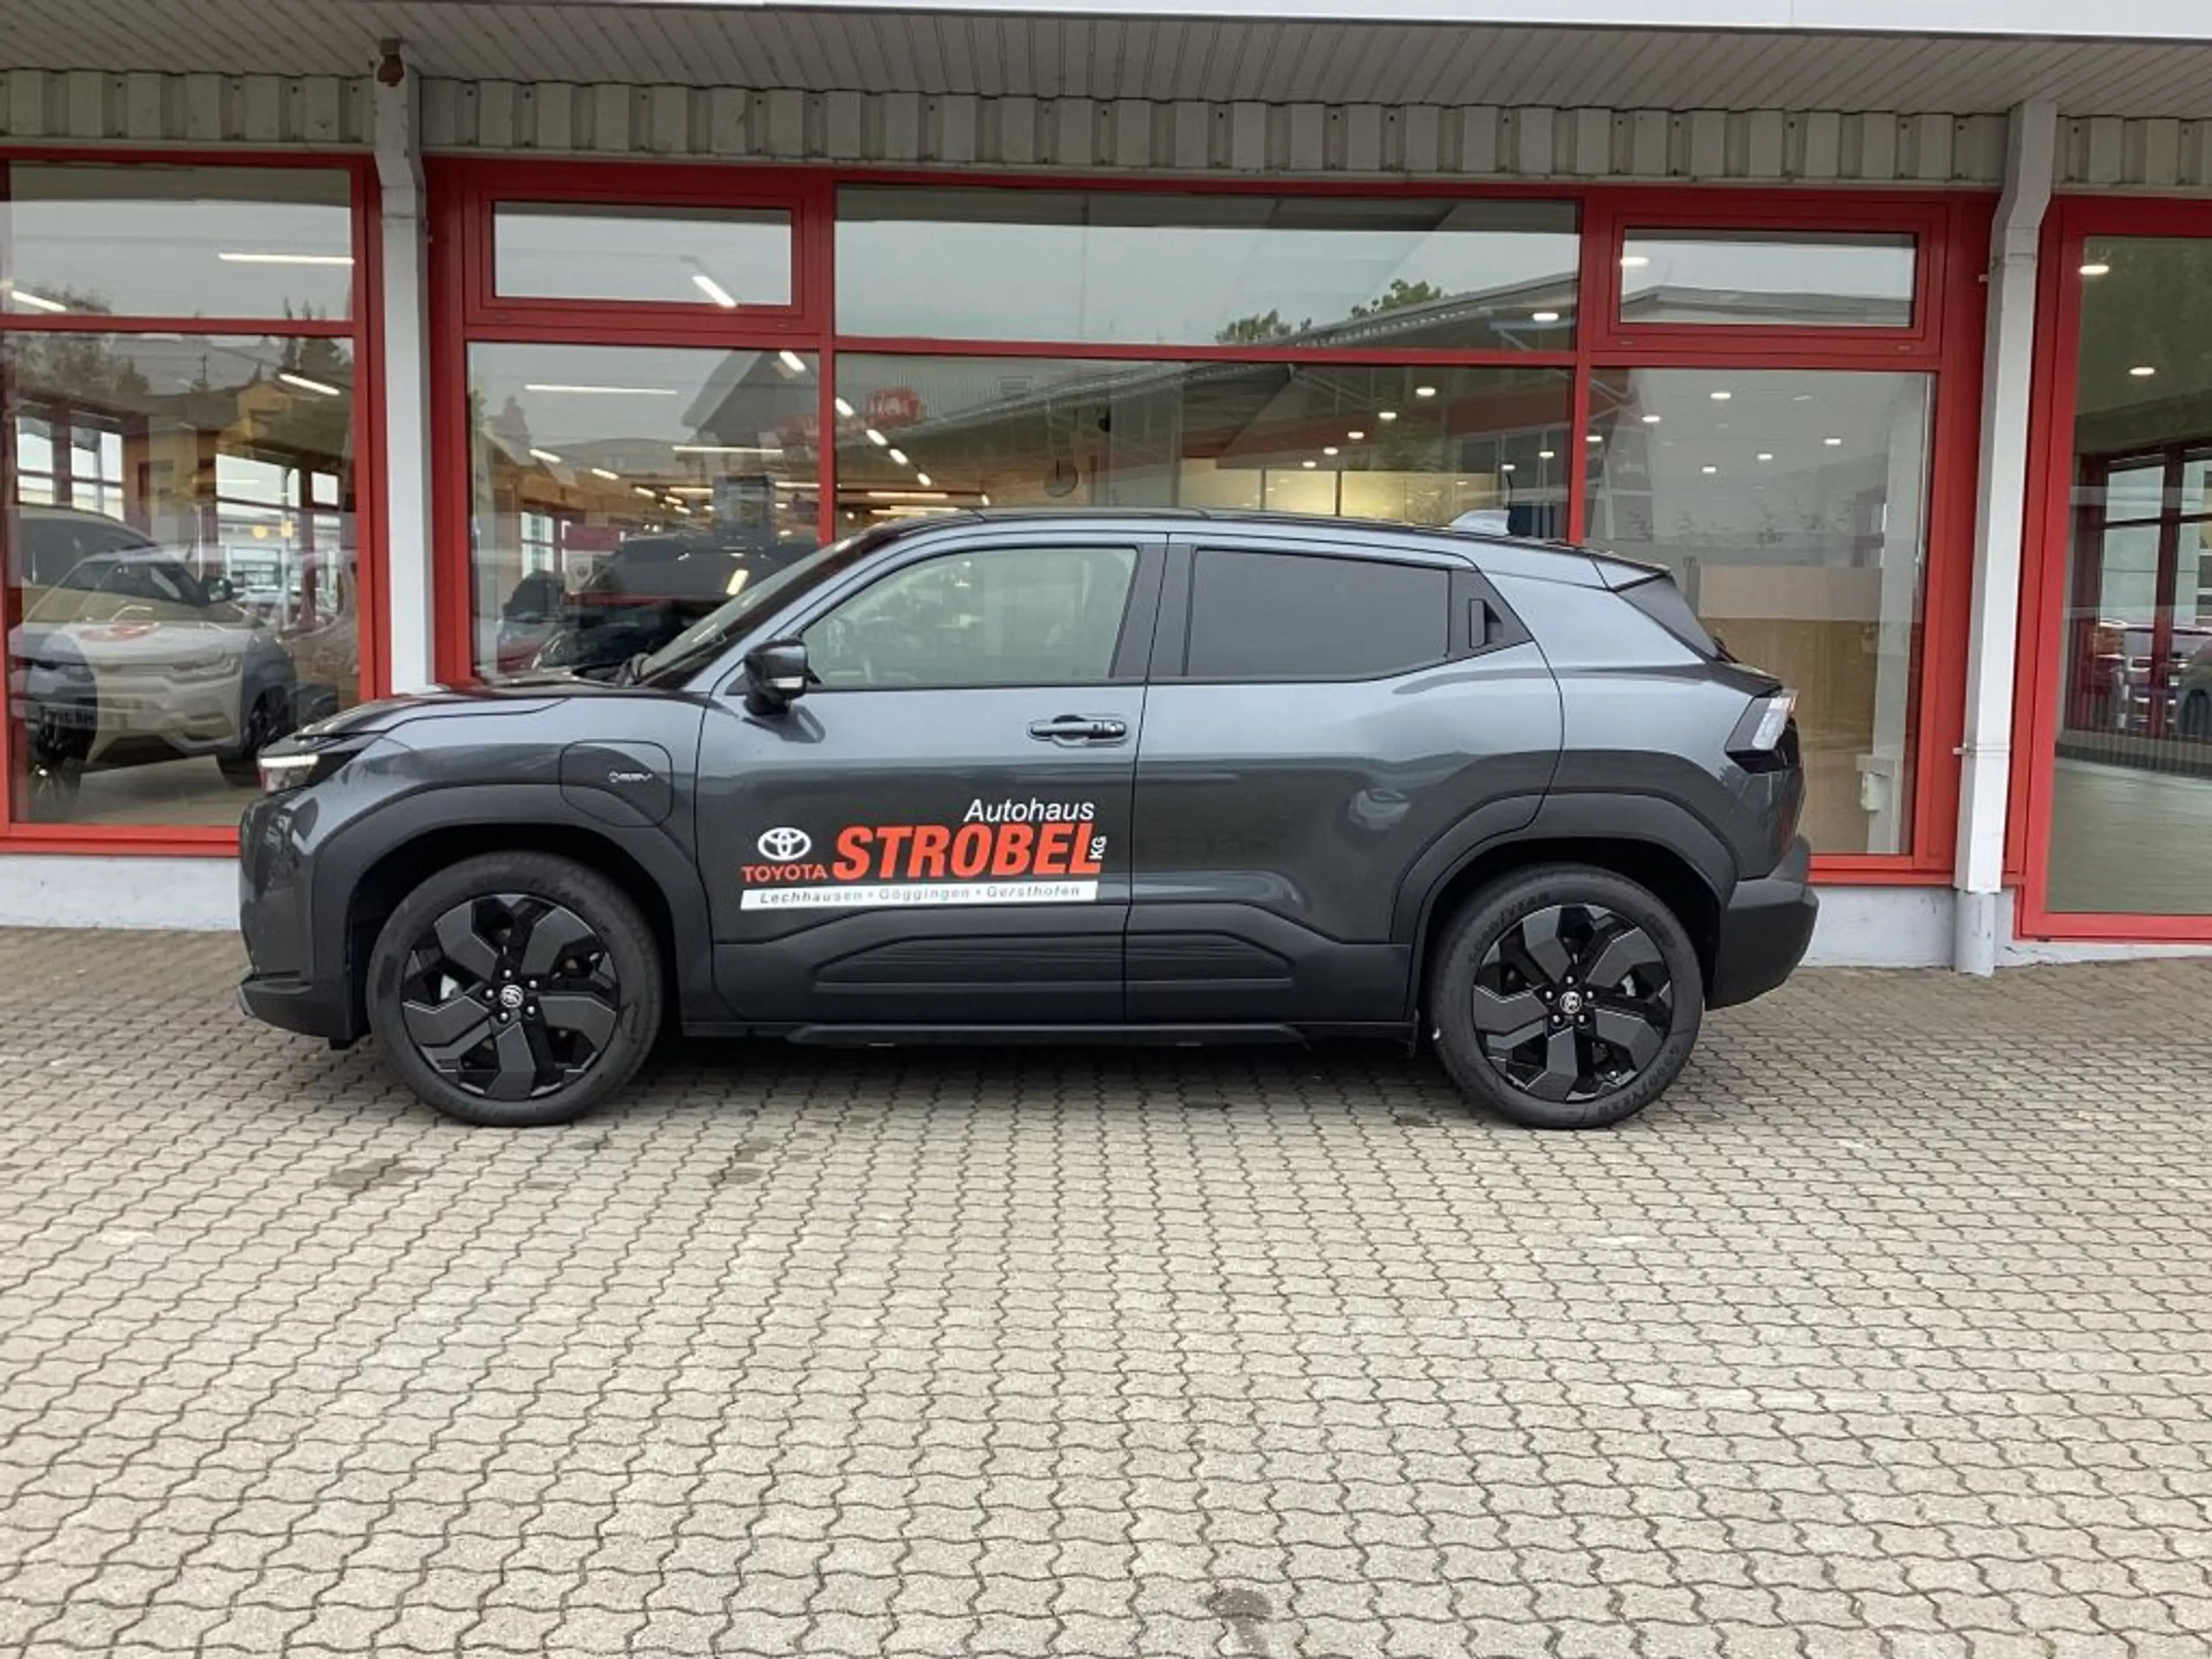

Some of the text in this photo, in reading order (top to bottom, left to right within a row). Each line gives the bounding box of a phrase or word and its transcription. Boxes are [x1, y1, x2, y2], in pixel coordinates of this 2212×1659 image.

[964, 797, 1094, 822] Autohaus
[834, 824, 1100, 879] STROBEL
[1088, 835, 1107, 860] KG
[741, 864, 828, 882] TOYOTA
[760, 891, 863, 904] Lechhausen
[987, 885, 1080, 897] Gersthofen
